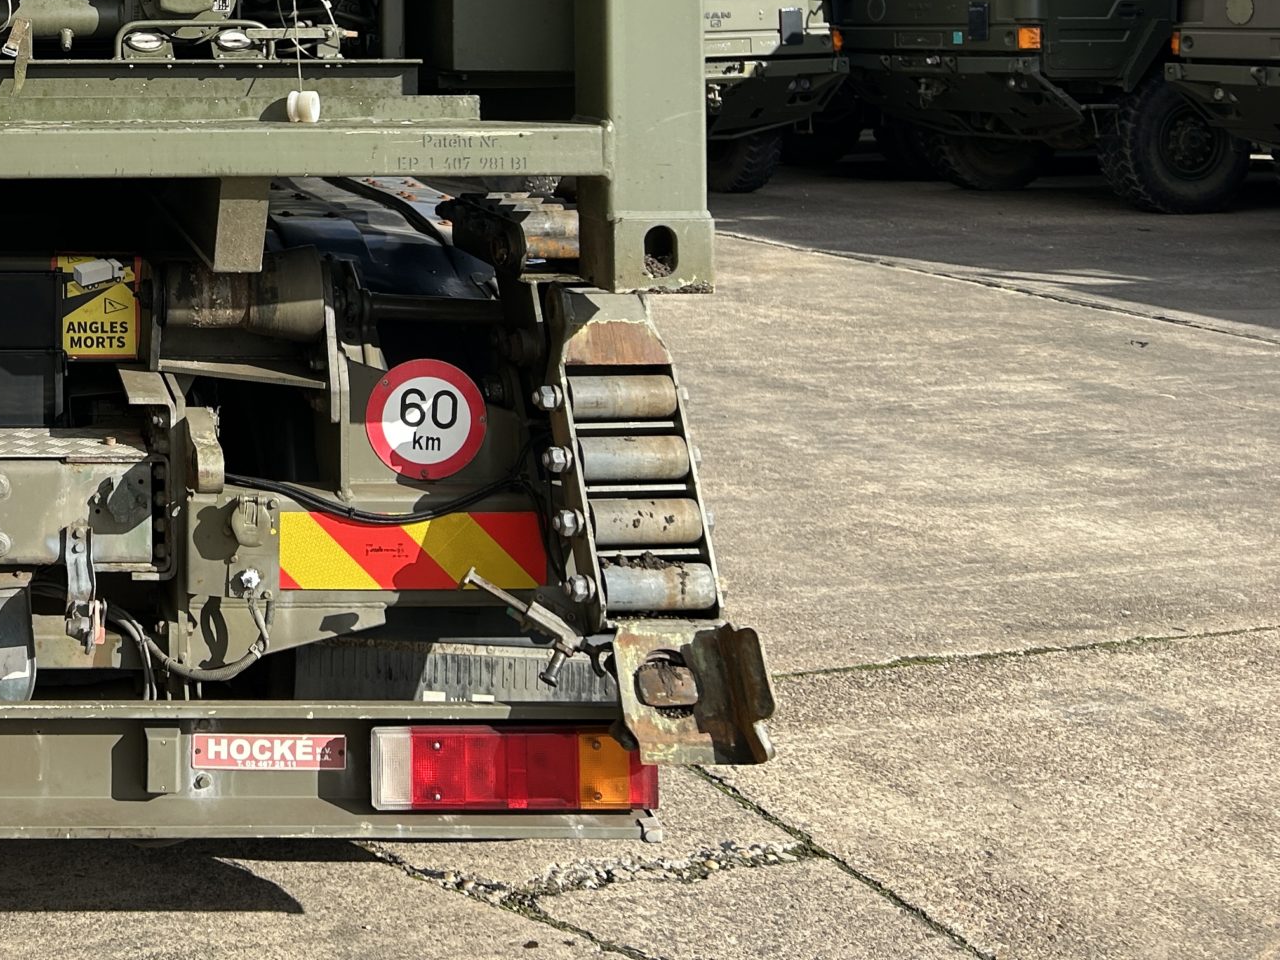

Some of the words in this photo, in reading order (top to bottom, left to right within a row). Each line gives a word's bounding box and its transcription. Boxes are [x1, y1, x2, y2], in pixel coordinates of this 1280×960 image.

[422, 134, 472, 148] Patent
[397, 157, 418, 170] EP
[66, 321, 128, 334] ANGLES
[70, 336, 126, 349] MORTS
[400, 388, 458, 430] 60
[412, 431, 441, 451] km
[207, 735, 314, 761] HOCKÉ
